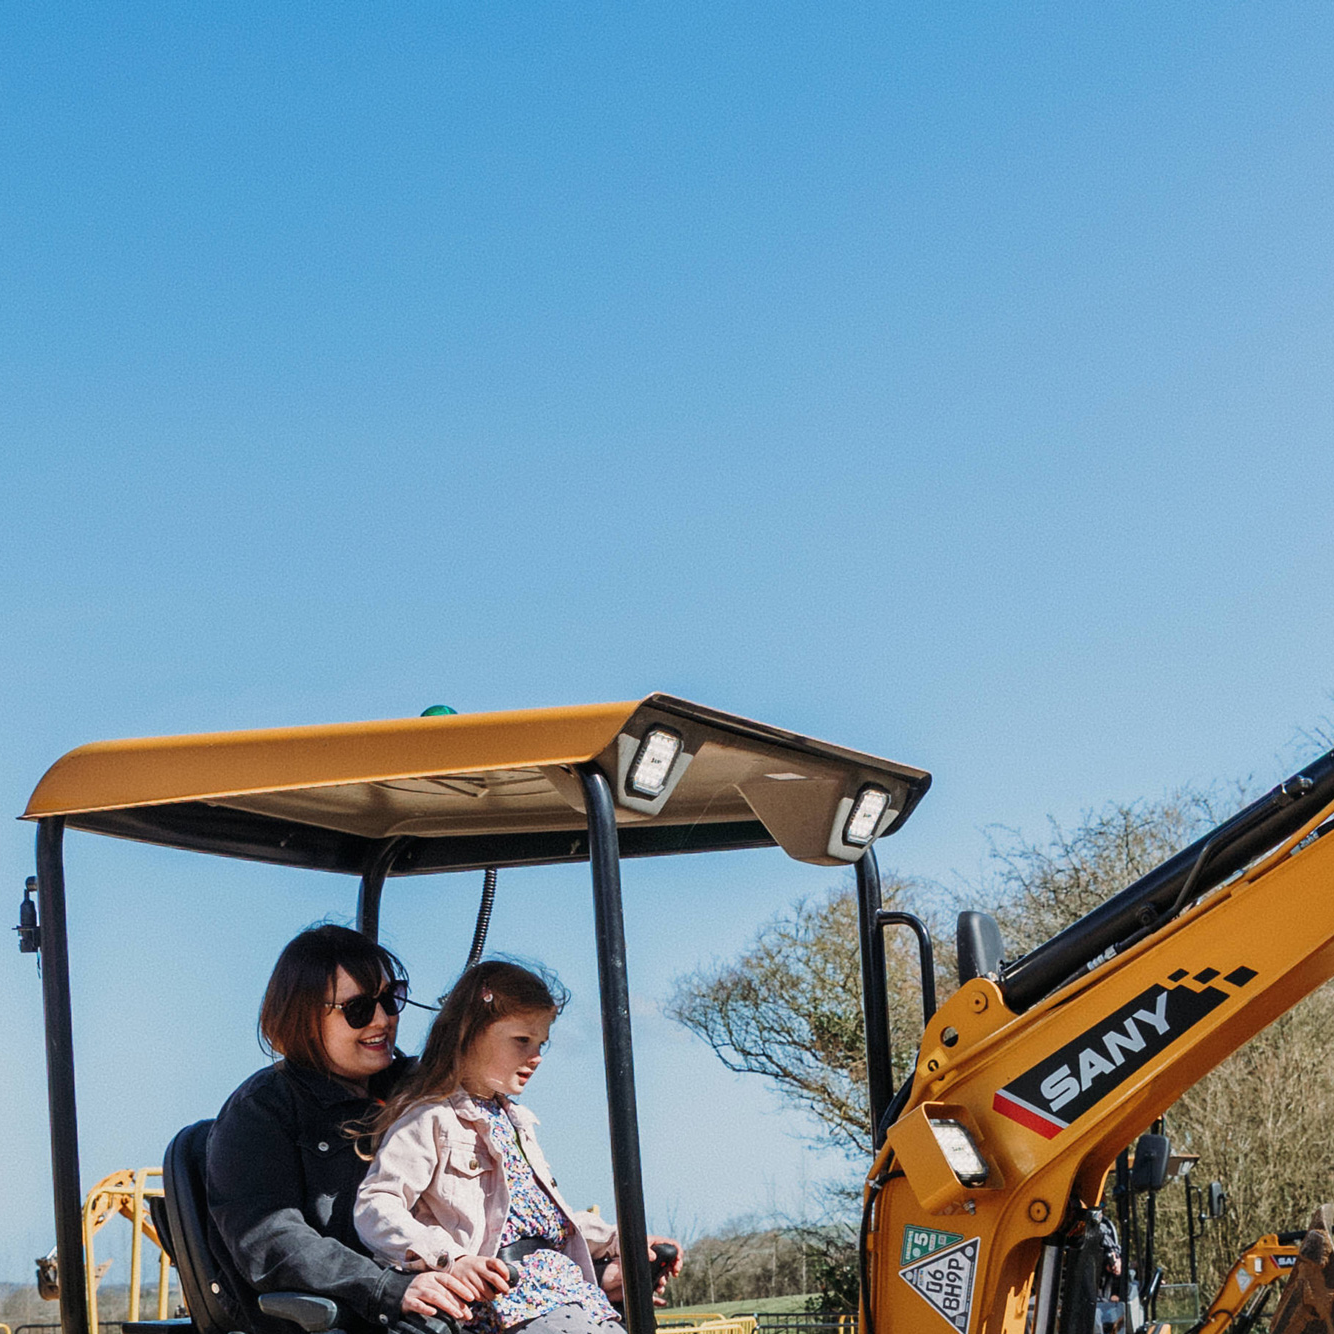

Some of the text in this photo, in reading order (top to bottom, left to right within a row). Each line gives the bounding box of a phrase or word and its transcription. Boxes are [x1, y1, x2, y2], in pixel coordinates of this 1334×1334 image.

[1040, 991, 1170, 1112] SANY
[914, 1232, 929, 1247] 5
[942, 1257, 965, 1311] BH9P
